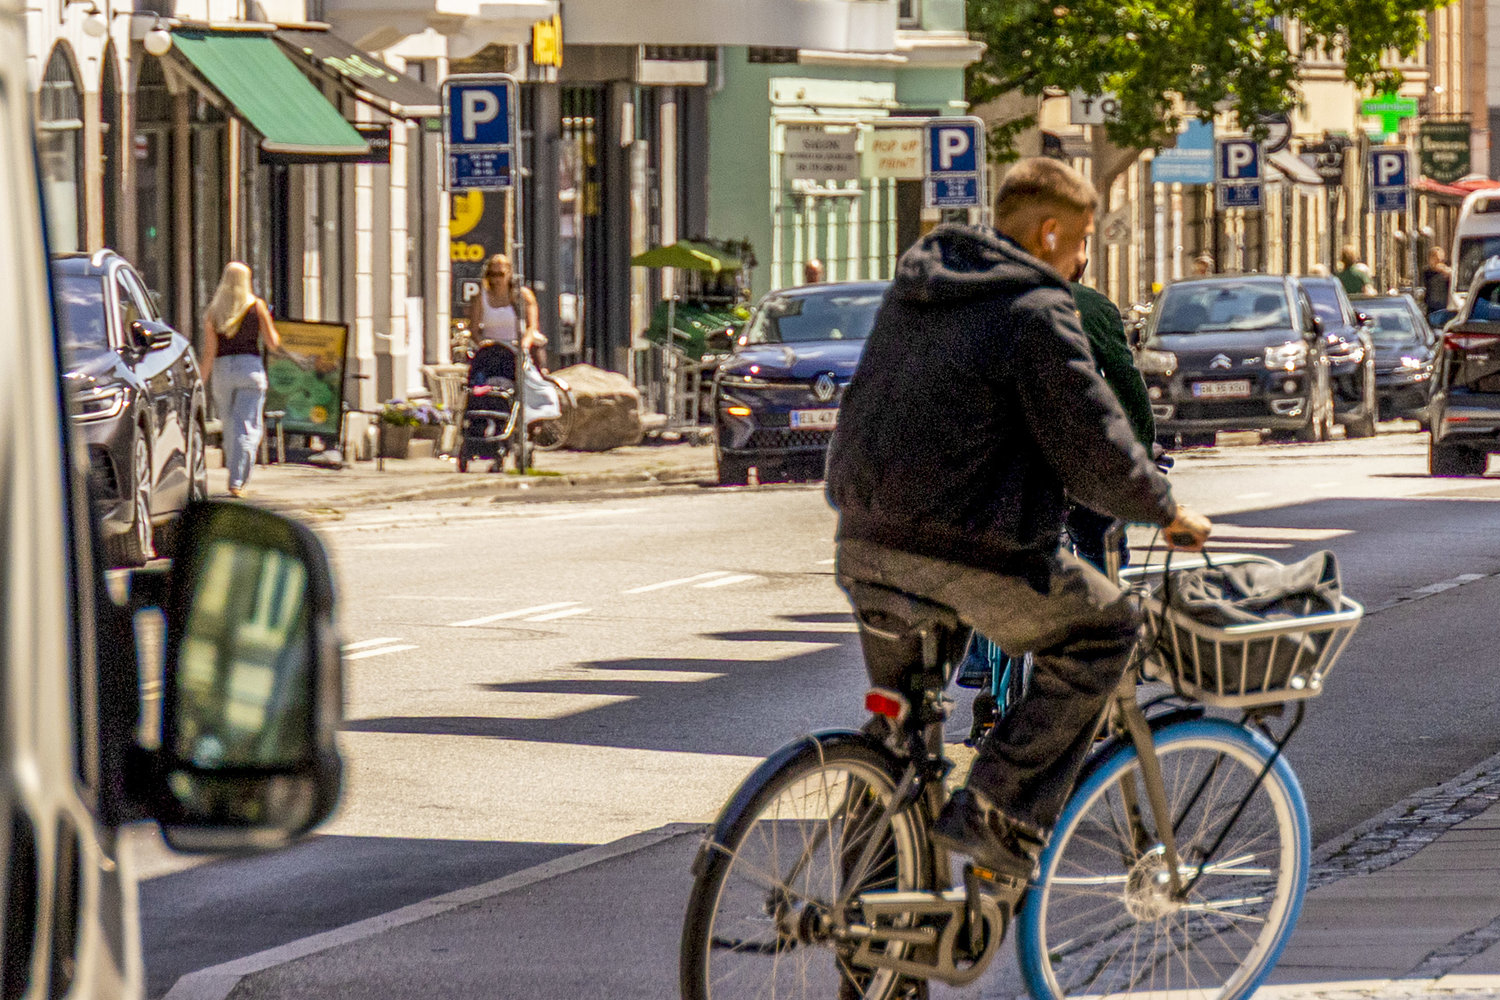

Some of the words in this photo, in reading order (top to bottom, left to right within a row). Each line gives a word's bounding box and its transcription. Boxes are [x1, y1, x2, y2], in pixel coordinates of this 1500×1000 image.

[462, 89, 500, 141] P
[938, 129, 970, 169] P
[1227, 143, 1254, 178] P
[1378, 154, 1400, 185] P
[463, 282, 480, 301] P
